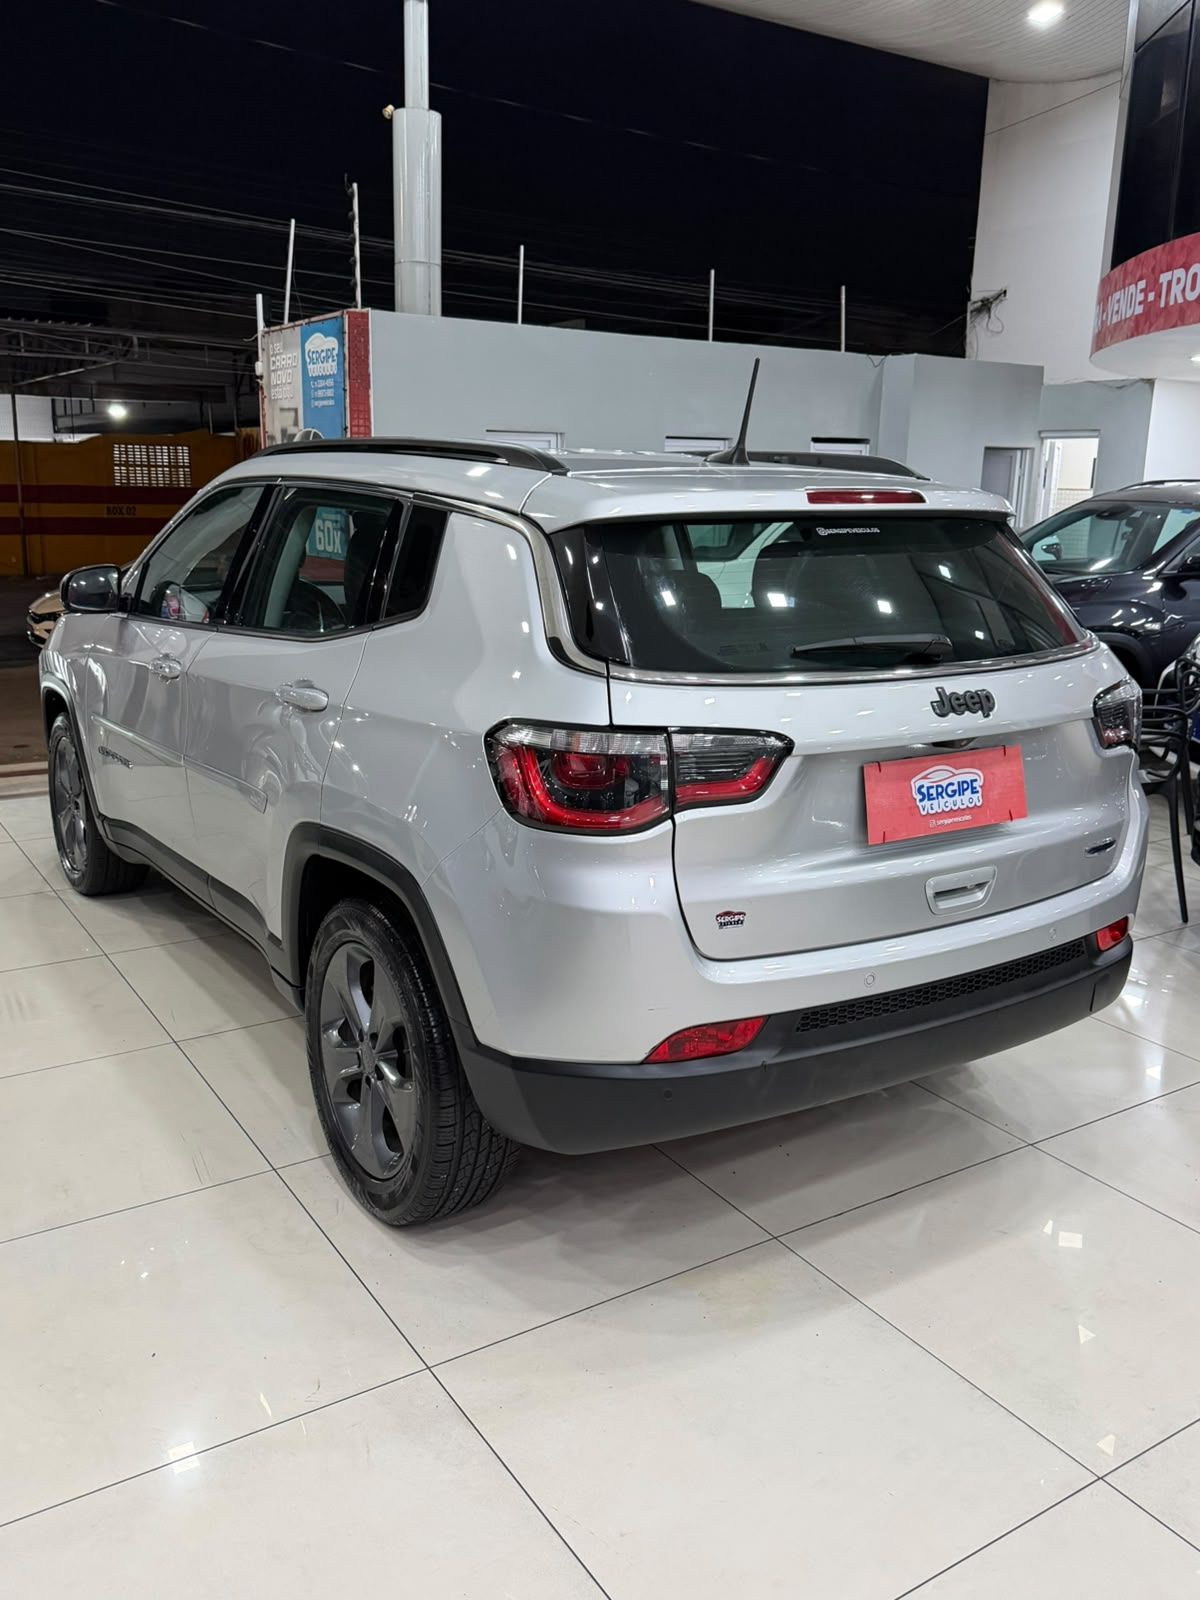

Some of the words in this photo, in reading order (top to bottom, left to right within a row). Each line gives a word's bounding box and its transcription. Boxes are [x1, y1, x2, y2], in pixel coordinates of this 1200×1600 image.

[271, 353, 297, 370] CARRO
[307, 348, 336, 365] SERGIPE
[272, 370, 292, 385] NOVO
[930, 686, 996, 718] Jeep
[917, 779, 979, 802] SERGIPE
